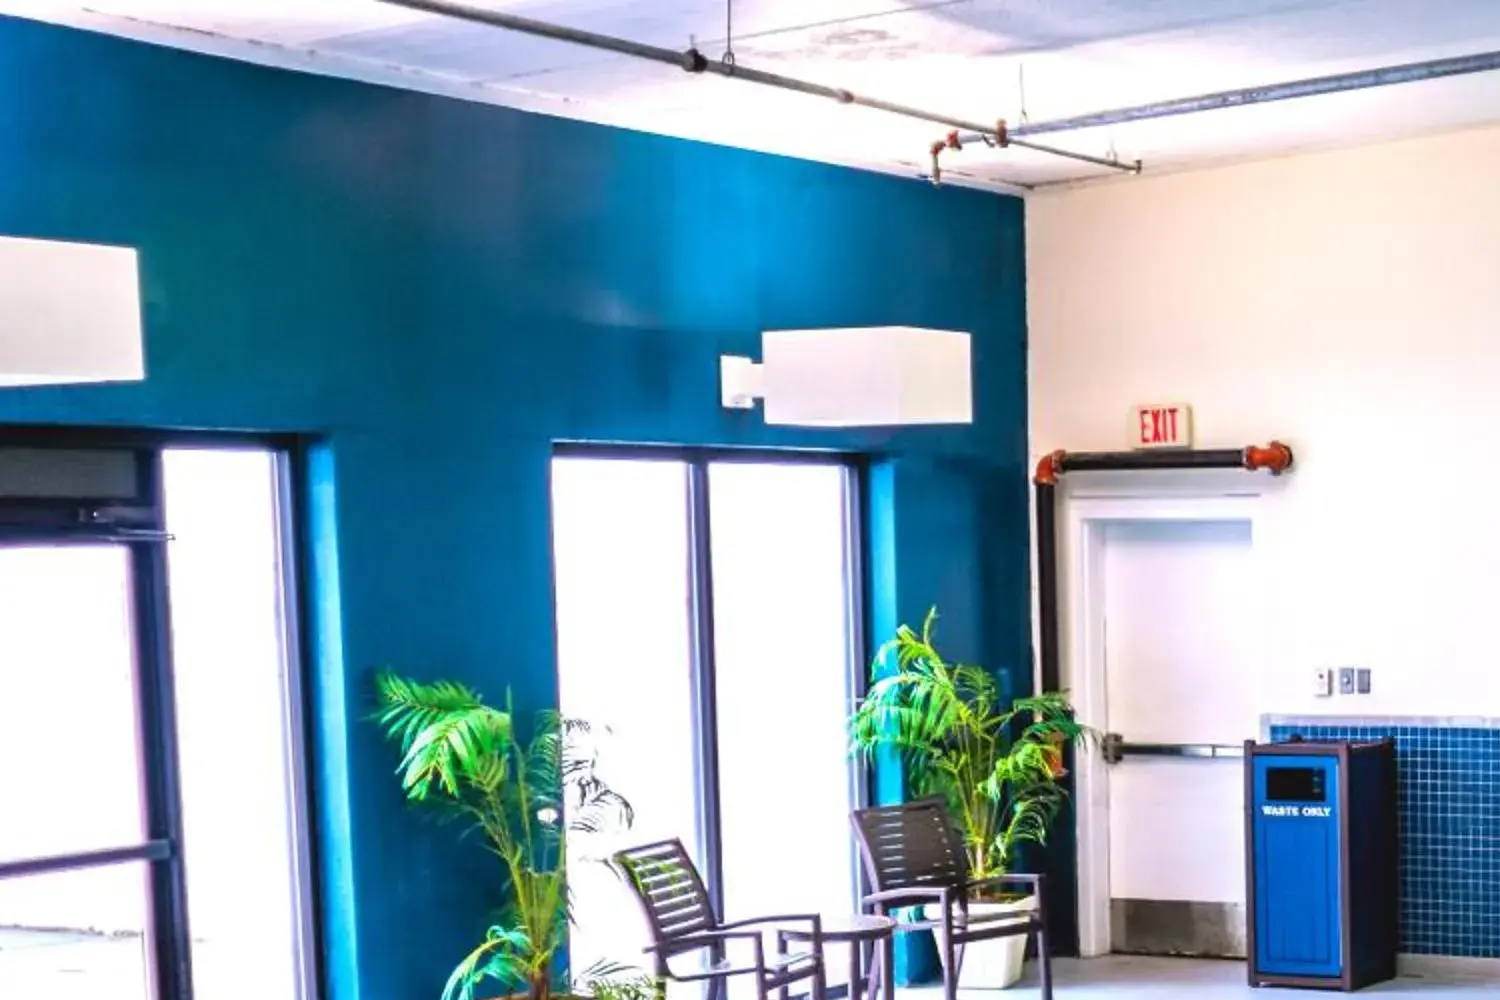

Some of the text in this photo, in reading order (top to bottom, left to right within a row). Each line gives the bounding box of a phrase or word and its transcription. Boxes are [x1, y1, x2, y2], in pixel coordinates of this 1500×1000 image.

[1139, 408, 1177, 443] EXIT
[1262, 805, 1332, 816] WASTE ONLY
